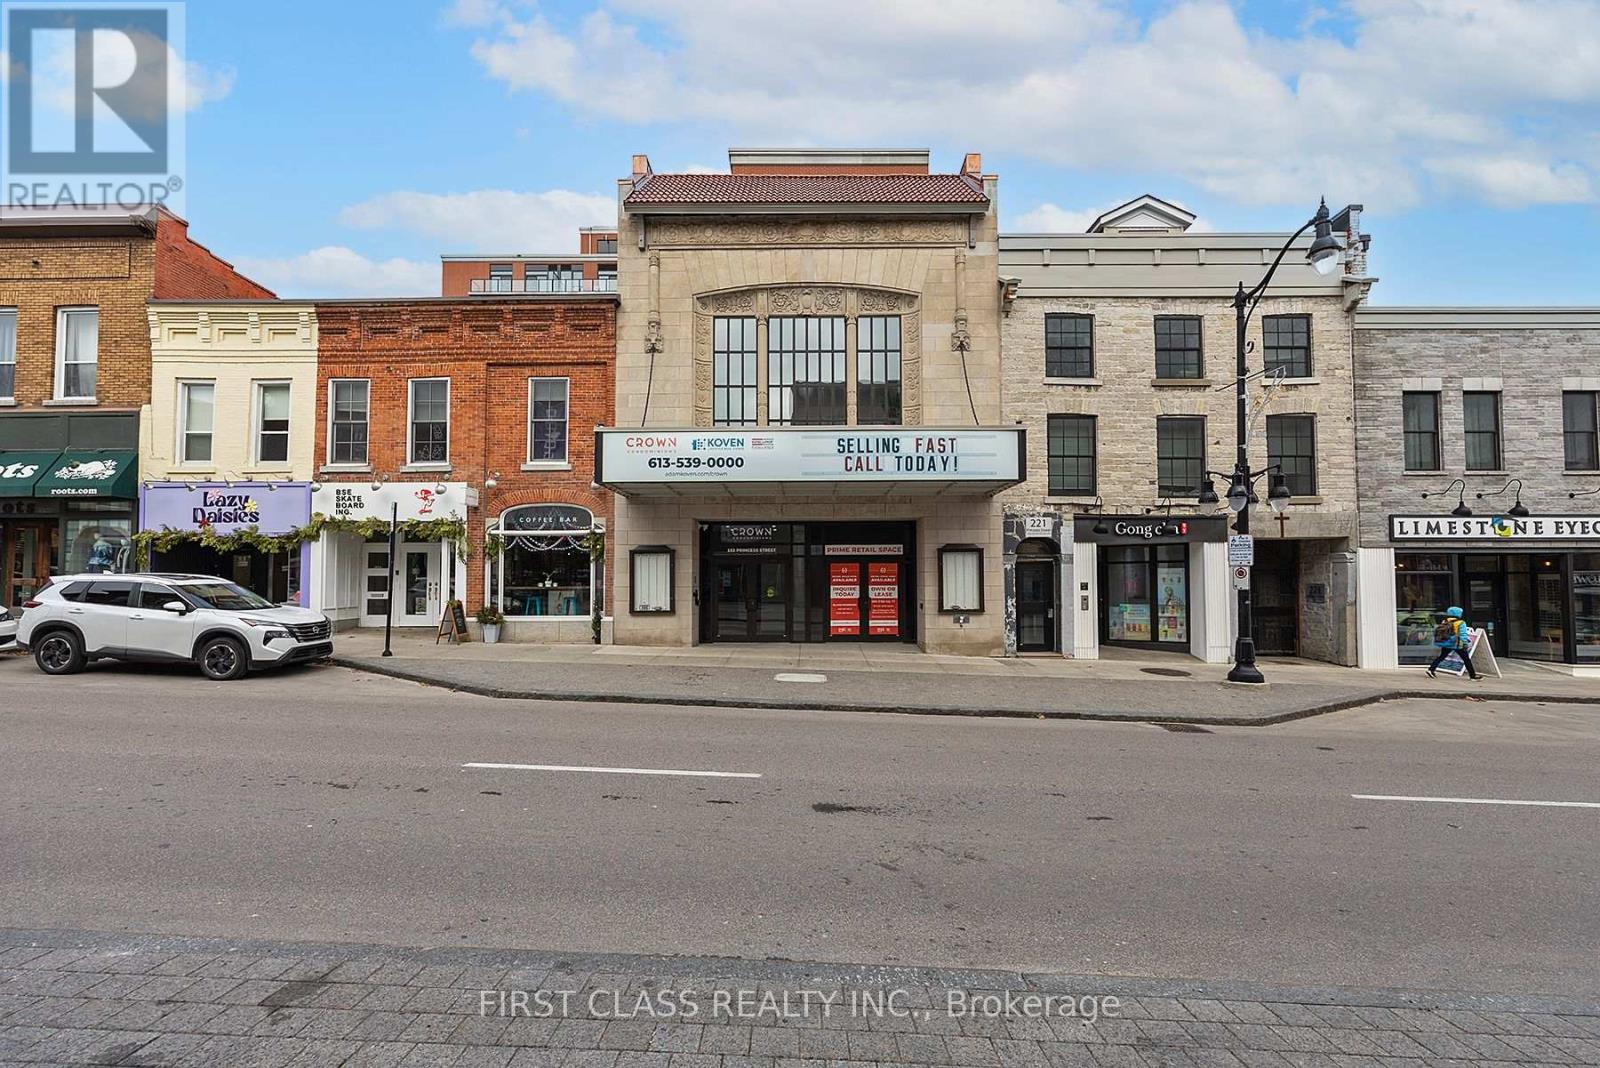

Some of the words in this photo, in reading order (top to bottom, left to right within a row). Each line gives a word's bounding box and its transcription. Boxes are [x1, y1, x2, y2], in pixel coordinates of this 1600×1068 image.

[626, 437, 677, 448] CROWN
[707, 437, 745, 448] KOVEN
[837, 437, 900, 453] SELLING
[915, 437, 957, 453] FAST
[648, 457, 745, 468] 613-539-0000
[844, 456, 883, 472] CALL
[895, 456, 958, 472] TODAY!
[203, 491, 250, 511] Lazy
[192, 507, 260, 523] Daisies
[1030, 518, 1046, 528] 221
[731, 527, 773, 537] CROWN
[1115, 522, 1153, 539] Gong
